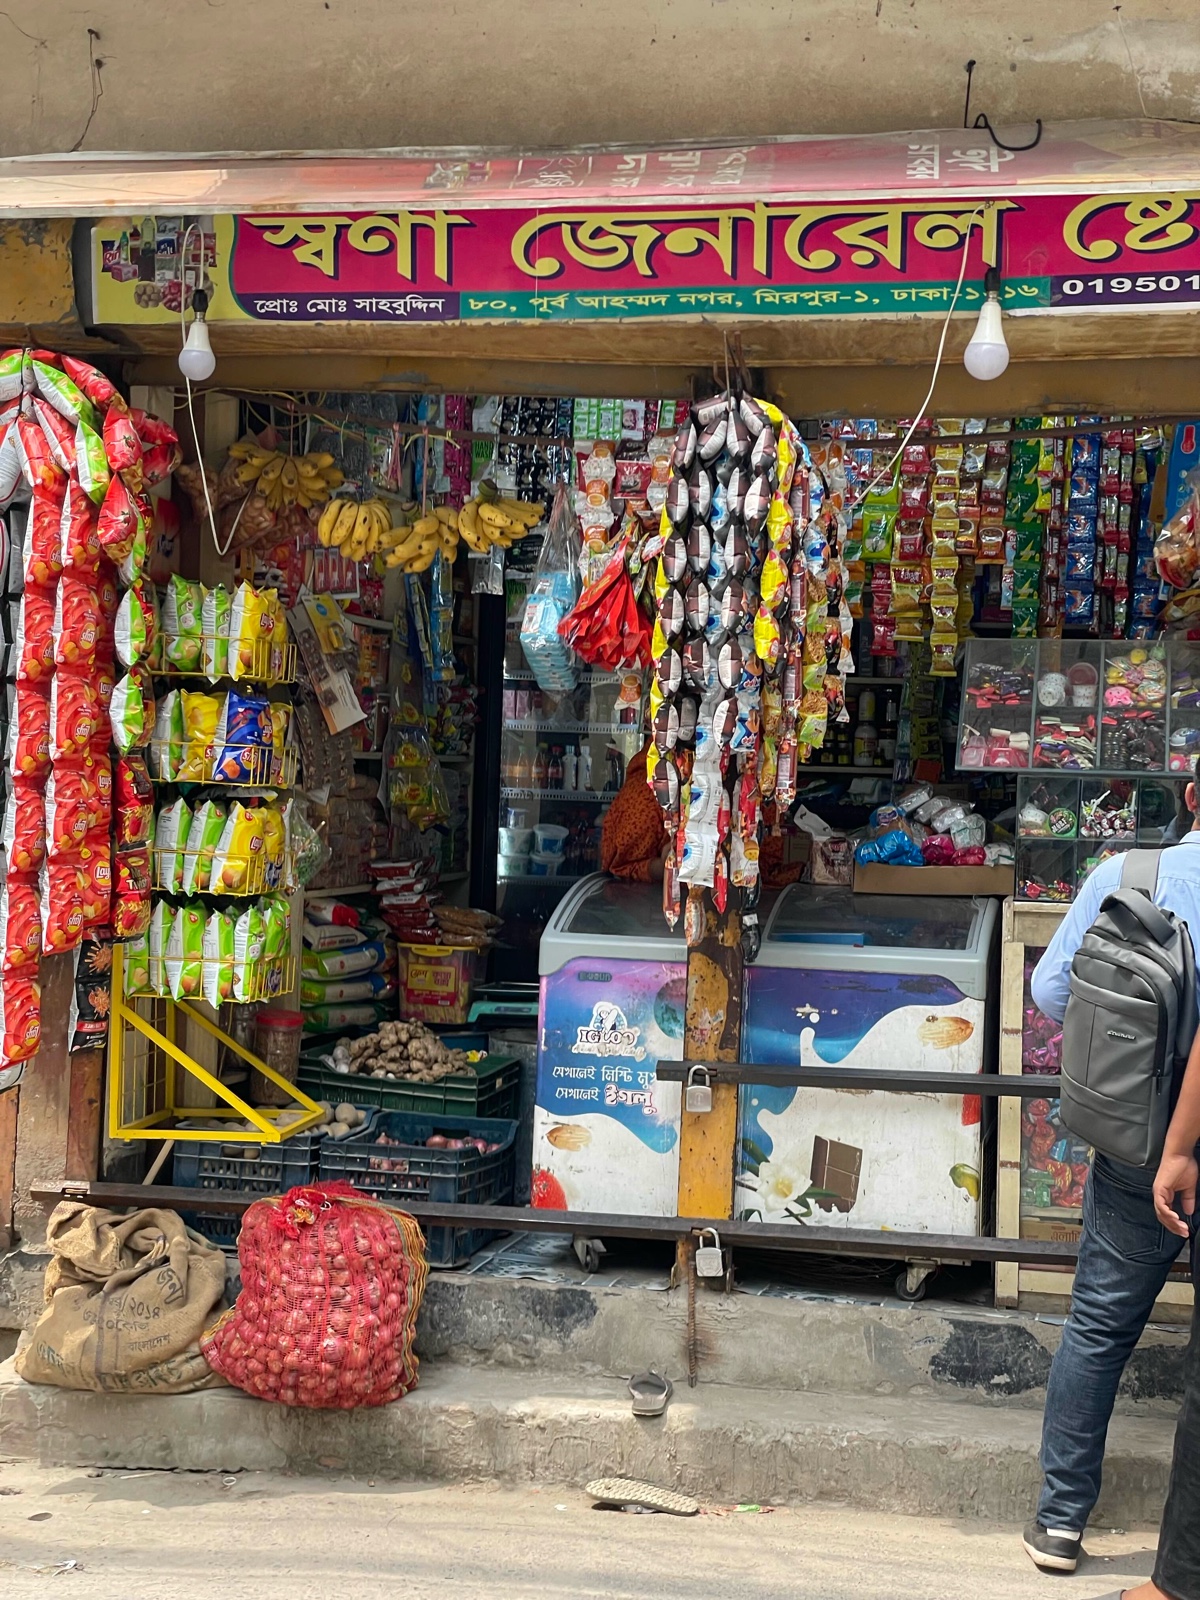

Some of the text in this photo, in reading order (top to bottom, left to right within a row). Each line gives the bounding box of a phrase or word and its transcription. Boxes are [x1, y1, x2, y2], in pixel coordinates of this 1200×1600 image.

[511, 198, 1023, 279] জেনারেল
[1062, 275, 1200, 295] 019501
[254, 298, 298, 314] প্রোঃ
[306, 297, 347, 314] মোঃ
[529, 293, 572, 313] পূর্ব
[576, 294, 671, 310] আহম্মদ
[677, 291, 743, 308] নগর,
[753, 288, 880, 307] মিরপুর-১,
[890, 284, 1039, 301] ঢাকা-১১৬
[580, 1029, 635, 1046] IGLOO
[552, 1065, 597, 1080] যেখানেই
[555, 1086, 600, 1101] সেখানেই
